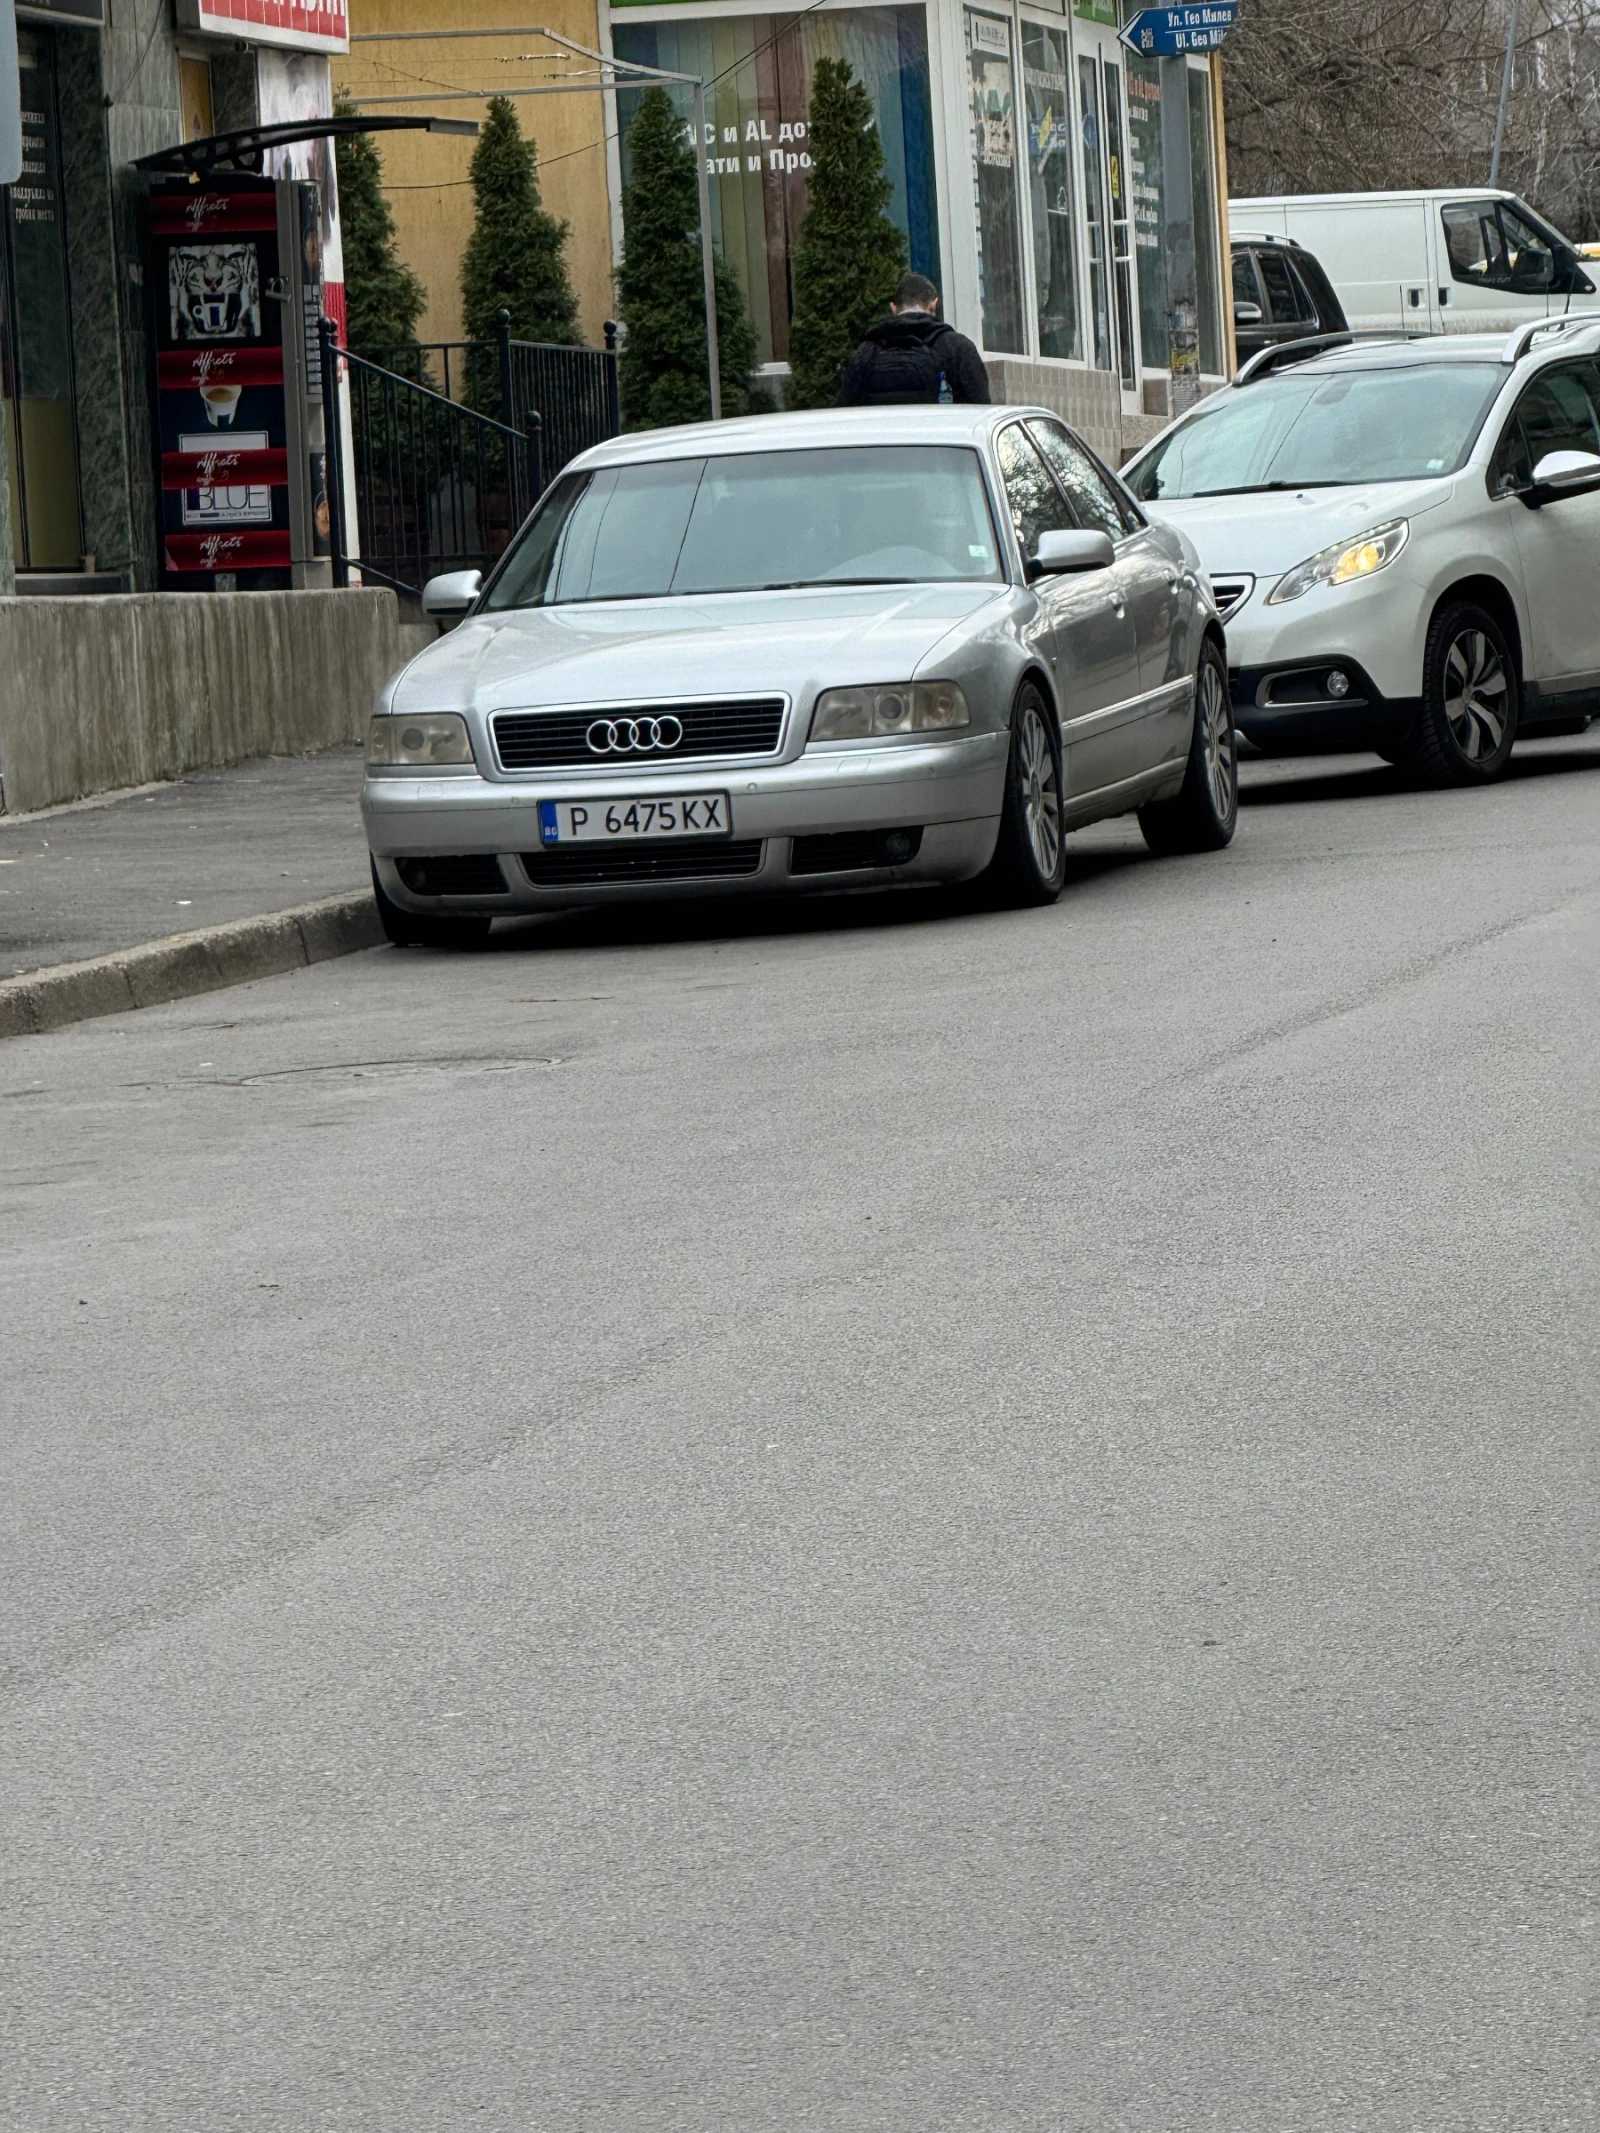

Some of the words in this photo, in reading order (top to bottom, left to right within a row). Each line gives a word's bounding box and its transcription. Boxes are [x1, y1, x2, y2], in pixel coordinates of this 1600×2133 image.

[1168, 12, 1183, 27] Ул.
[1185, 10, 1200, 25] Гео
[1202, 9, 1232, 23] Милев
[1176, 33, 1190, 48] Ul.
[1191, 32, 1208, 46] Geo
[1210, 30, 1228, 45] Mil
[724, 126, 738, 143] и
[745, 119, 772, 142] AL
[706, 156, 740, 174] ати
[748, 154, 762, 172] и
[769, 149, 816, 174] Про
[199, 484, 268, 511] BLUE
[570, 807, 589, 836] P
